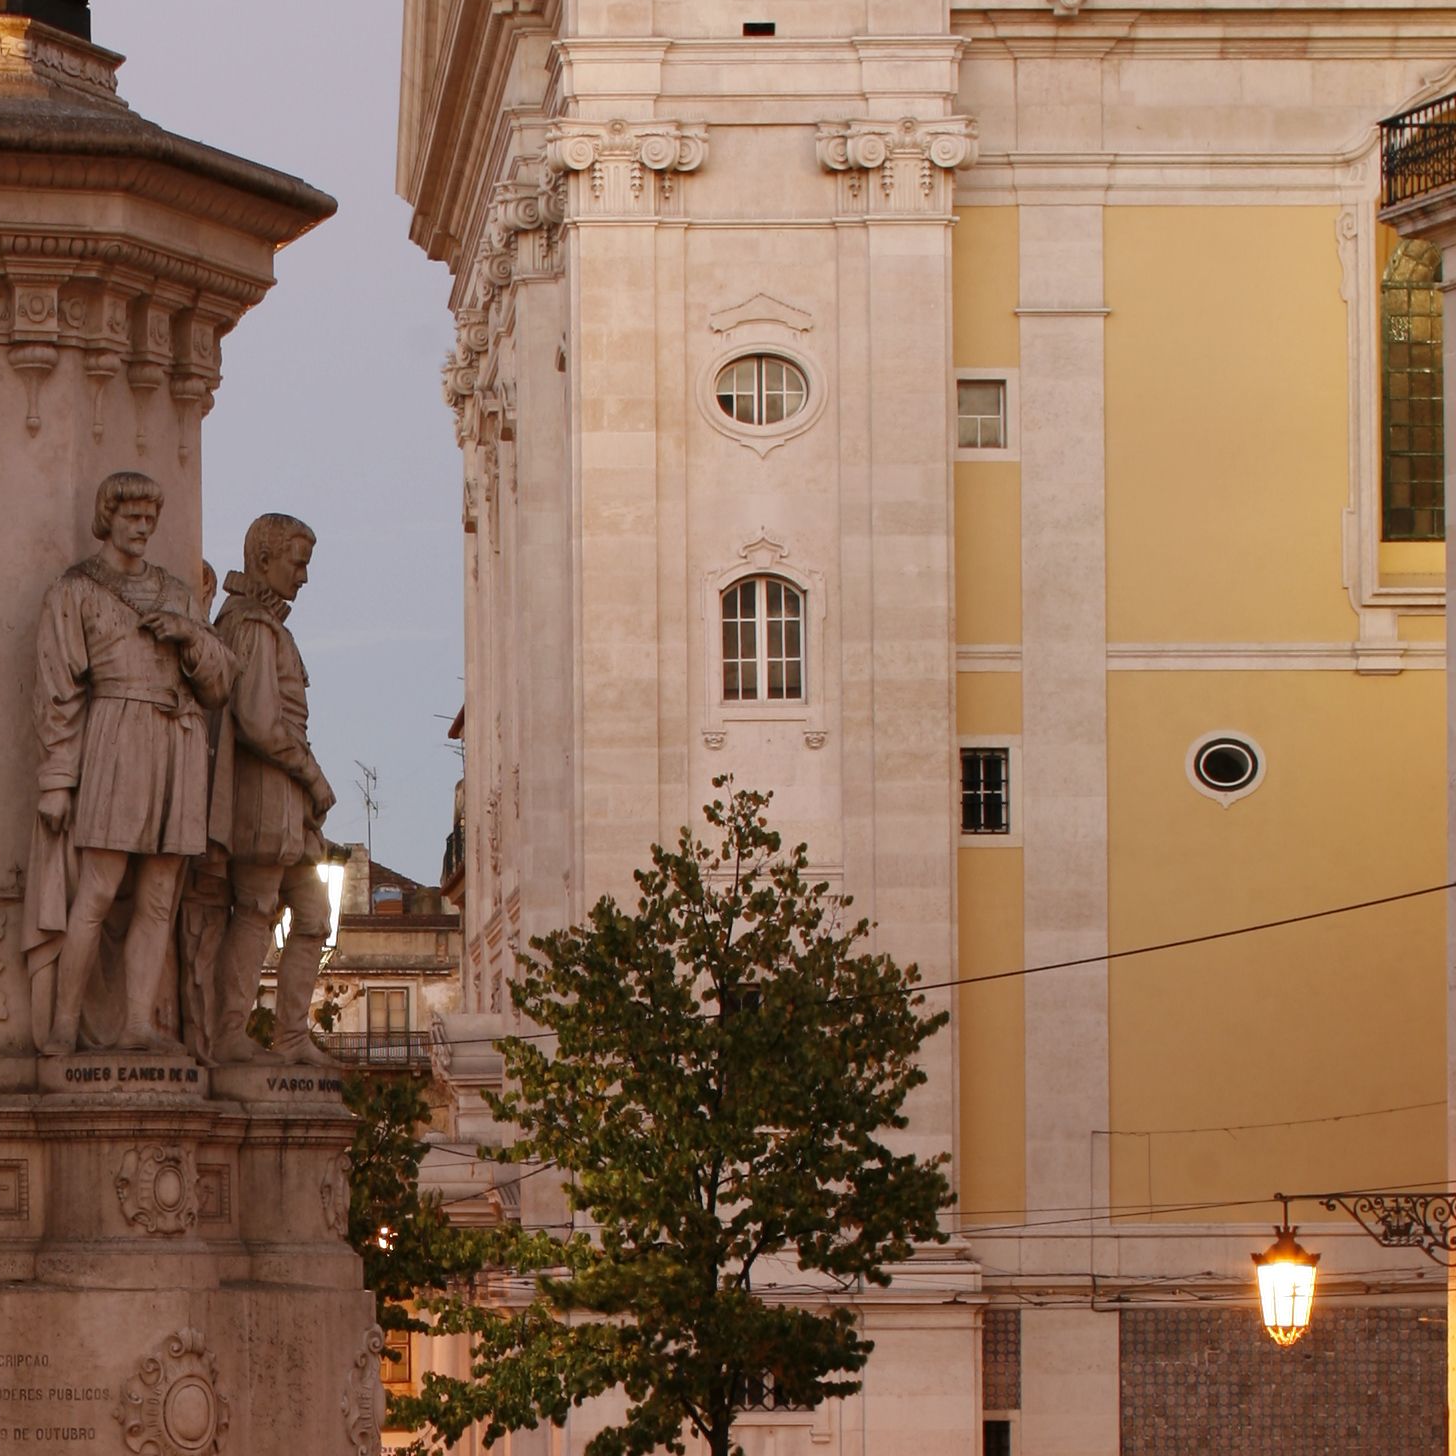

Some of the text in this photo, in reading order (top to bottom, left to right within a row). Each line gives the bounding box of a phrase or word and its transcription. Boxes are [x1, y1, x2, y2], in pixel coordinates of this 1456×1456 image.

[65, 1068, 111, 1082] GOMES
[169, 1068, 183, 1082] DE
[266, 1078, 314, 1092] VASCO
[13, 1428, 29, 1441] DE
[35, 1427, 96, 1441] OUTUBRO
